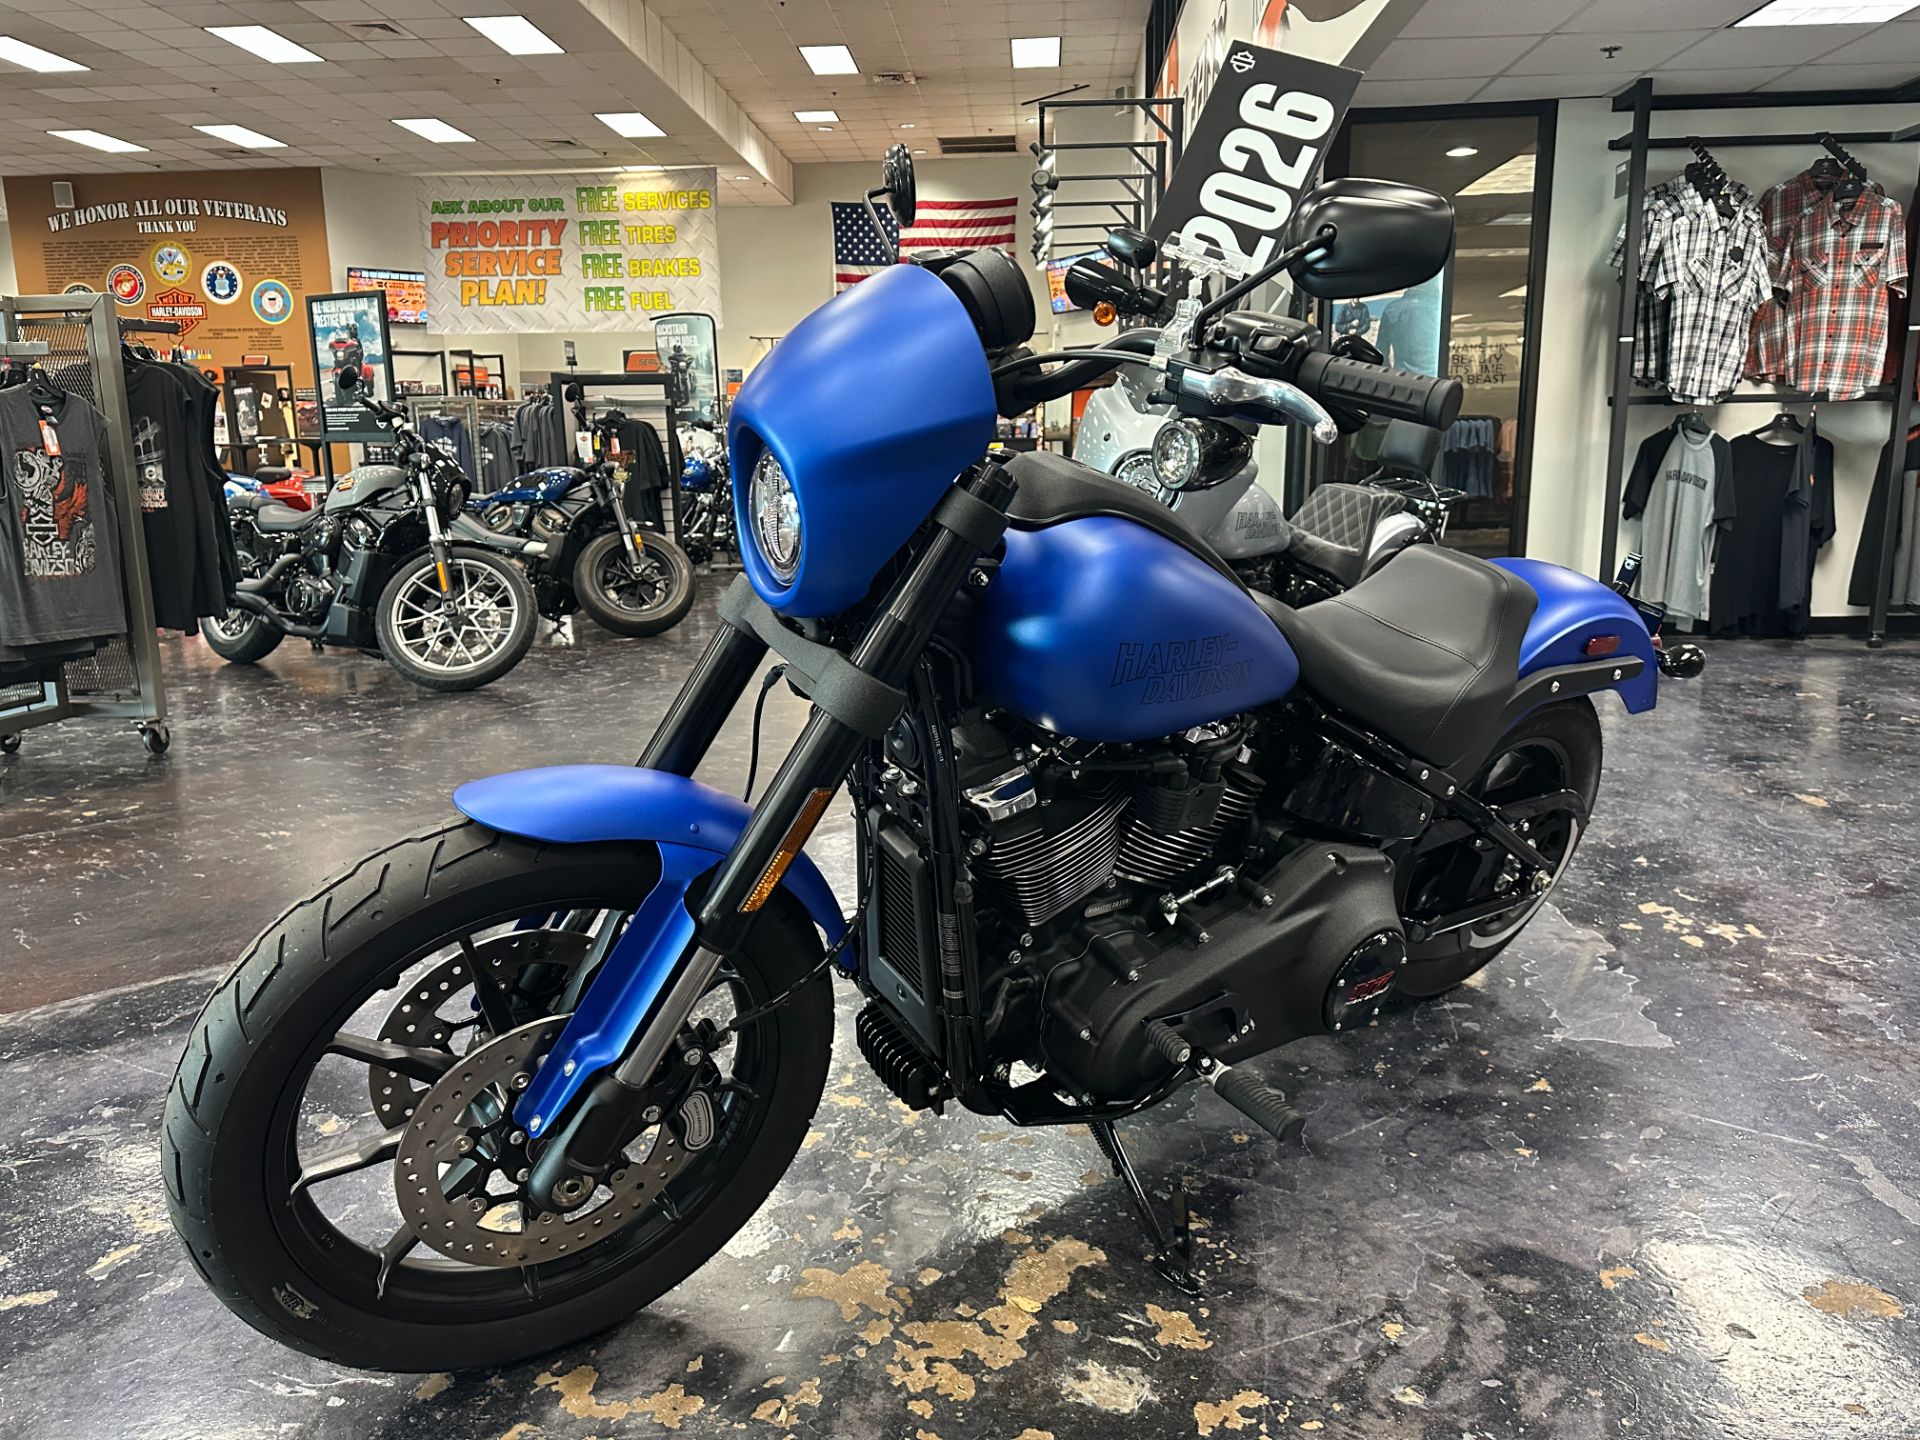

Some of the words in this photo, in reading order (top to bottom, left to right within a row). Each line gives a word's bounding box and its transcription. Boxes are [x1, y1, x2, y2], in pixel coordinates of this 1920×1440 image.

[1179, 83, 1335, 275] 2026
[431, 200, 465, 214] ASK
[467, 199, 525, 214] ABOUT
[528, 198, 565, 212] OUR
[576, 186, 619, 213] FREE
[623, 190, 712, 211] SERVICES
[48, 212, 71, 232] WE
[73, 202, 130, 226] HONOR
[133, 199, 162, 217] ALL
[164, 198, 200, 215] OUR
[202, 199, 288, 227] VETERANS
[136, 221, 174, 233] THANK
[176, 220, 197, 233] YOU
[431, 219, 568, 249] PRIORITY
[578, 220, 621, 246] FREE
[625, 225, 677, 245] TIRES
[444, 249, 562, 277] SERVICE
[581, 253, 623, 279] FREE
[628, 257, 701, 278] BRAKES
[162, 293, 190, 304] MOTOR
[461, 279, 547, 306] PLAN!
[584, 286, 625, 312] FREE
[630, 292, 674, 310] FUEL
[151, 306, 203, 317] HARLEY-DAVIDSON
[1467, 374, 1507, 384] BEAST
[1111, 633, 1239, 687] HARLEY-
[1140, 658, 1254, 705] DAVIDSON
